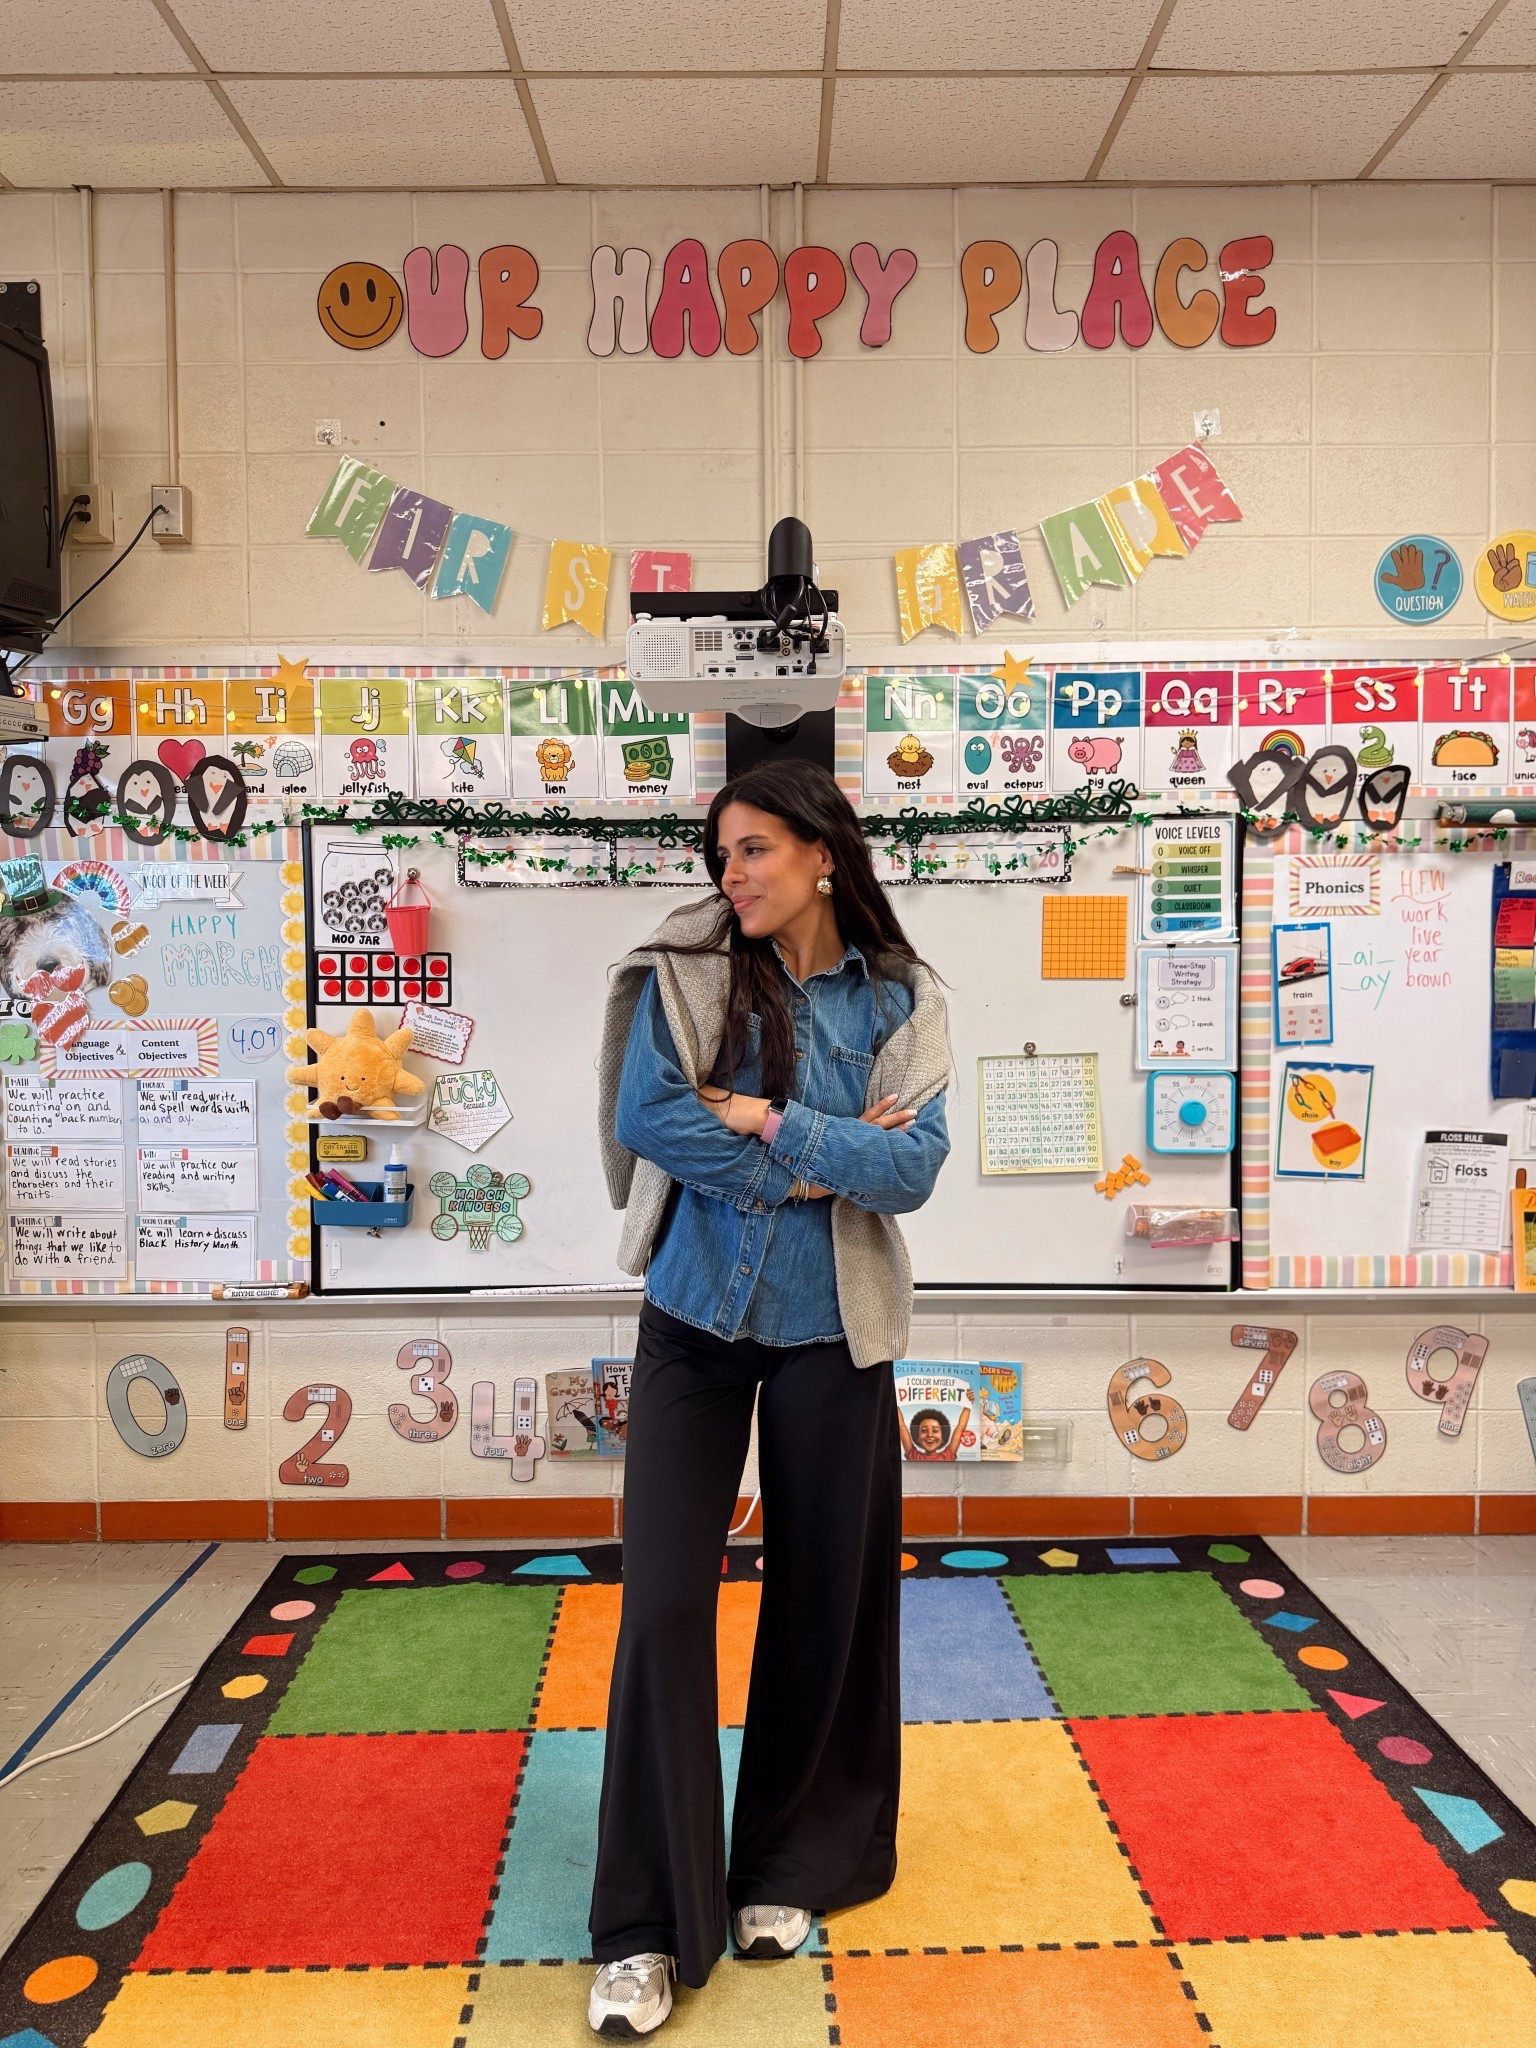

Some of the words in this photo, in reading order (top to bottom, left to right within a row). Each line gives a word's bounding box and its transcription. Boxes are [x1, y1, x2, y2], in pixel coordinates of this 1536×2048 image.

[587, 239, 917, 358] HAPPY
[961, 231, 1276, 353] PLACE
[1396, 595, 1443, 611] QUESTION
[1504, 592, 1535, 608] WATER
[1258, 679, 1306, 715] Rr
[1354, 676, 1396, 712] Ss
[1448, 676, 1487, 711] Tt
[155, 688, 207, 724] Hh
[255, 687, 286, 724] Ii
[434, 687, 486, 724] Kk
[539, 688, 568, 724] Ll
[884, 686, 937, 720] Nn
[976, 684, 1031, 719] Oo
[1072, 681, 1123, 724] Pp
[1160, 679, 1218, 723] Qq
[62, 689, 114, 732] Gg
[351, 687, 380, 731] Jj
[1169, 776, 1205, 787] queen
[1452, 771, 1477, 781] taco
[282, 784, 307, 794] igloo
[340, 781, 390, 795] jellyfish
[451, 782, 474, 793] kite
[545, 782, 566, 794] lion
[628, 783, 668, 795] money
[897, 778, 921, 790] nest
[967, 780, 989, 790] oval
[1004, 779, 1043, 791] octopus
[1088, 777, 1104, 789] pig
[1155, 827, 1182, 839] VOICE
[1187, 827, 1220, 838] LEVELS
[1179, 846, 1196, 854] VOICE
[1199, 846, 1211, 854] OFF
[1159, 866, 1162, 874] 1
[1181, 866, 1208, 874] WHISPER
[170, 874, 183, 888] OF
[188, 875, 201, 888] THE
[204, 875, 228, 889] WEEK
[1158, 884, 1162, 892] 2
[1184, 884, 1202, 892] QUIET
[1305, 882, 1364, 894] Phonics
[1157, 903, 1161, 911] 3
[1174, 902, 1211, 910] CLASSROOM
[1402, 902, 1447, 922] work
[171, 914, 236, 939] HAPPY
[1156, 921, 1162, 929] 4
[332, 934, 354, 944] MOO
[359, 935, 380, 945] JAR
[1412, 926, 1444, 946] live
[1405, 949, 1443, 967] year
[161, 941, 282, 992] MARCH
[1406, 970, 1452, 987] brown
[71, 1040, 109, 1049] anguage
[232, 1027, 277, 1054] 4.09
[65, 1052, 114, 1062] Objectives
[138, 1051, 187, 1061] Objectives
[141, 1092, 154, 1101] We
[160, 1091, 177, 1101] will
[437, 1074, 497, 1107] Lucky
[140, 1101, 156, 1111] and
[160, 1101, 184, 1115] spell
[191, 1101, 222, 1113] words
[225, 1100, 249, 1113] with
[463, 1102, 486, 1110] because
[154, 1115, 171, 1123] and
[1302, 1111, 1319, 1119] chain
[1440, 1133, 1463, 1142] FLOSS
[1464, 1134, 1483, 1142] RULE
[1329, 1159, 1342, 1167] tray
[1455, 1165, 1487, 1177] floss
[455, 1189, 506, 1200] MARCH
[448, 1201, 511, 1213] KINDESS
[16, 1227, 29, 1237] We
[33, 1227, 53, 1238] will
[57, 1226, 86, 1238] write
[90, 1229, 117, 1239] about
[139, 1228, 152, 1237] We
[179, 1228, 203, 1237] learn
[214, 1227, 247, 1238] discuss
[15, 1239, 42, 1255] things
[47, 1241, 67, 1252] that
[90, 1242, 106, 1252] like
[110, 1242, 121, 1252] to
[140, 1239, 167, 1247] Black
[175, 1239, 209, 1252] History
[15, 1252, 28, 1265] do
[34, 1252, 59, 1264] with
[1238, 1338, 1269, 1349] seven
[920, 1367, 974, 1375] KAEPERNICK
[1228, 1325, 1298, 1431] 7
[1406, 1325, 1489, 1437] 9
[387, 1339, 459, 1443] 3
[899, 1387, 965, 1402] DIFFERENT
[1107, 1358, 1187, 1461] 6
[226, 1418, 245, 1426] one
[1309, 1370, 1386, 1474] 8
[1440, 1420, 1461, 1433] nine
[279, 1384, 352, 1487] 2
[408, 1429, 438, 1439] three
[470, 1377, 546, 1482] 4
[151, 1440, 175, 1454] zero
[484, 1446, 507, 1456] four
[1155, 1447, 1170, 1458] six
[1347, 1455, 1373, 1470] eight
[303, 1475, 324, 1484] two
